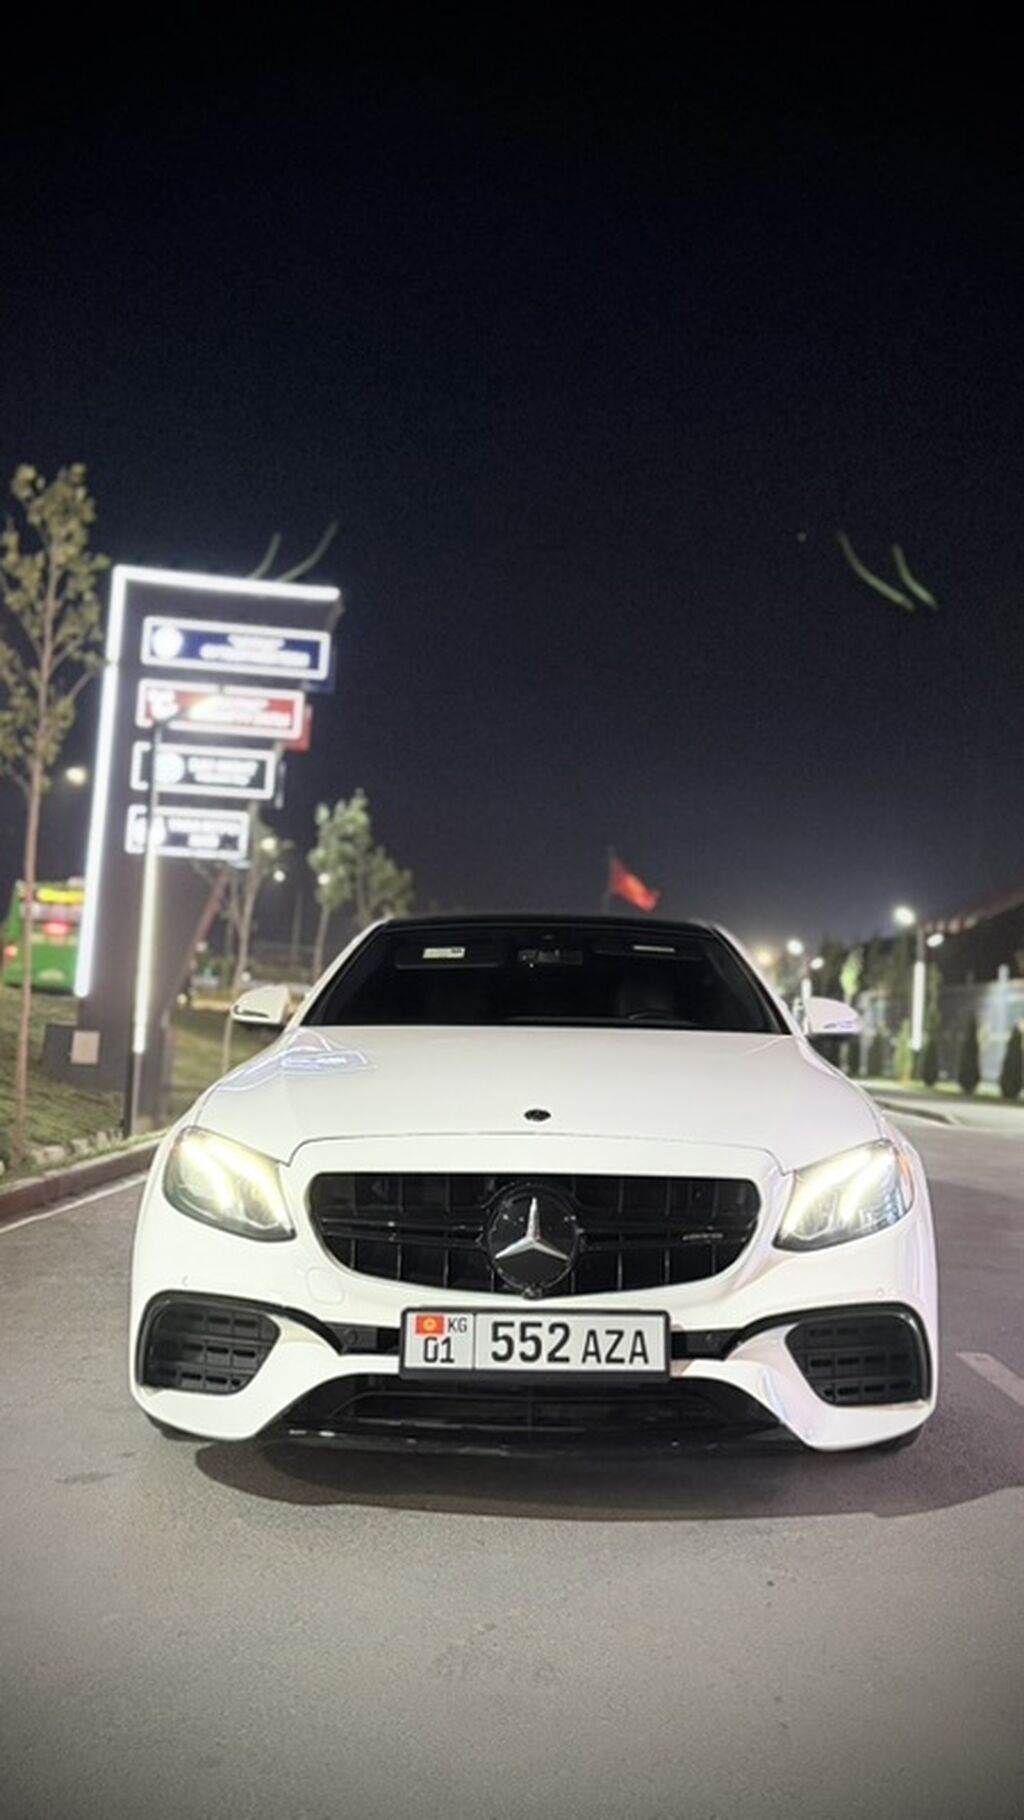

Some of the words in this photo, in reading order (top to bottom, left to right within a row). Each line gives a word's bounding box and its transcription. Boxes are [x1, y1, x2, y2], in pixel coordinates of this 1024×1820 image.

[448, 1317, 468, 1332] KG
[422, 1336, 455, 1364] 01
[491, 1321, 571, 1363] 552
[581, 1329, 649, 1364] AZA
